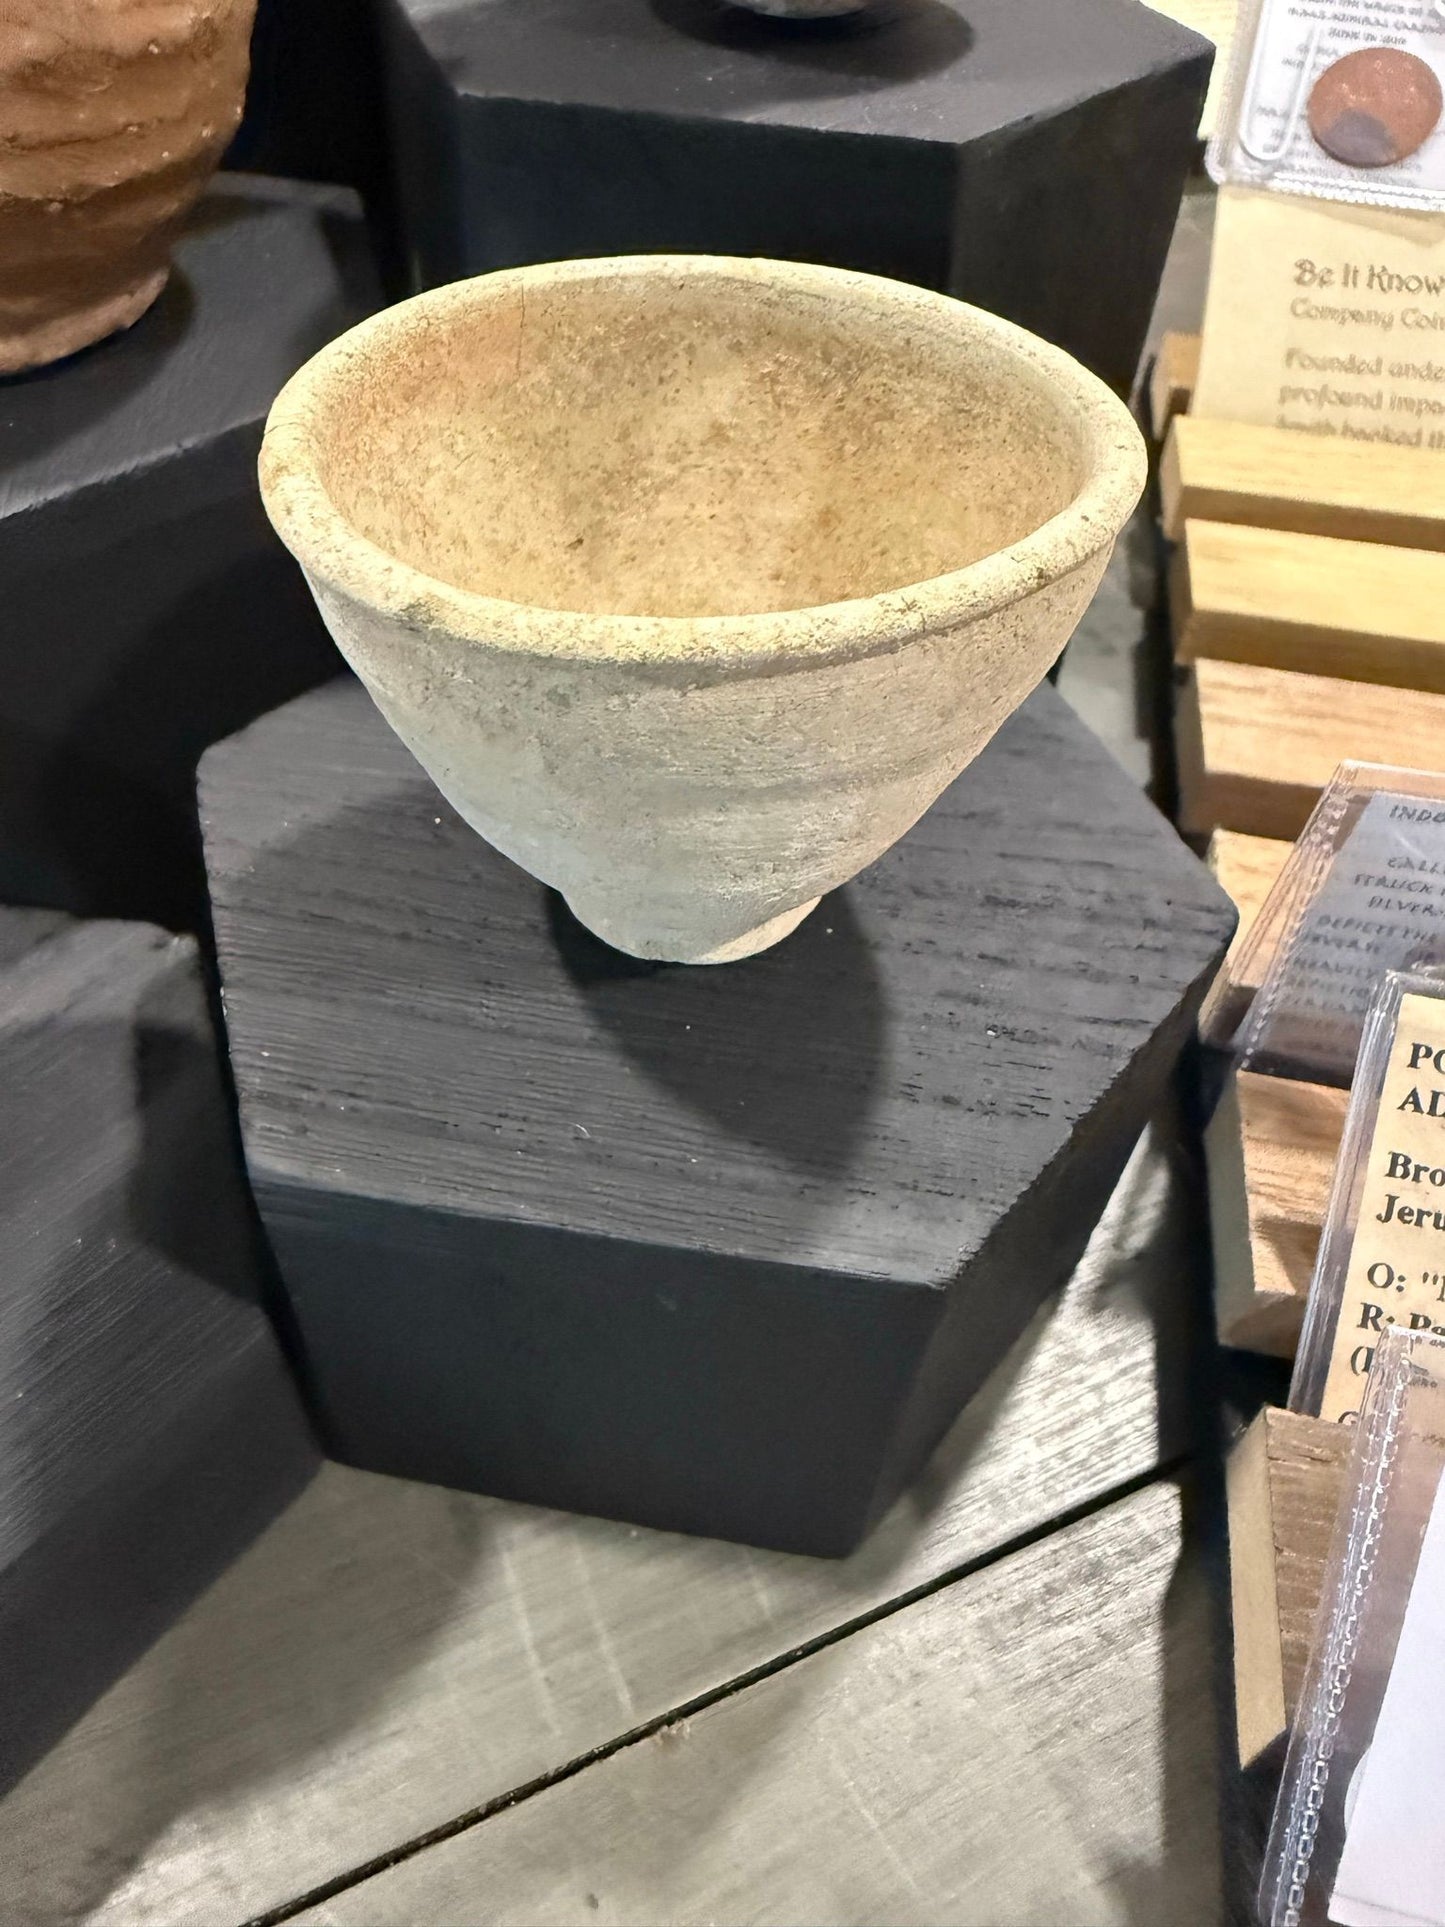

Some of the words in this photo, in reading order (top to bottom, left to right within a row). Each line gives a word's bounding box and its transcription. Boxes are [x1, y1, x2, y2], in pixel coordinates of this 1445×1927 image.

[1293, 258, 1334, 288] Be
[1290, 297, 1395, 331] Company
[1285, 348, 1383, 376] Founded
[1278, 384, 1384, 411] profound
[1396, 1086, 1445, 1118] AD
[1384, 1150, 1445, 1187] Bro
[1366, 1262, 1406, 1293] O:
